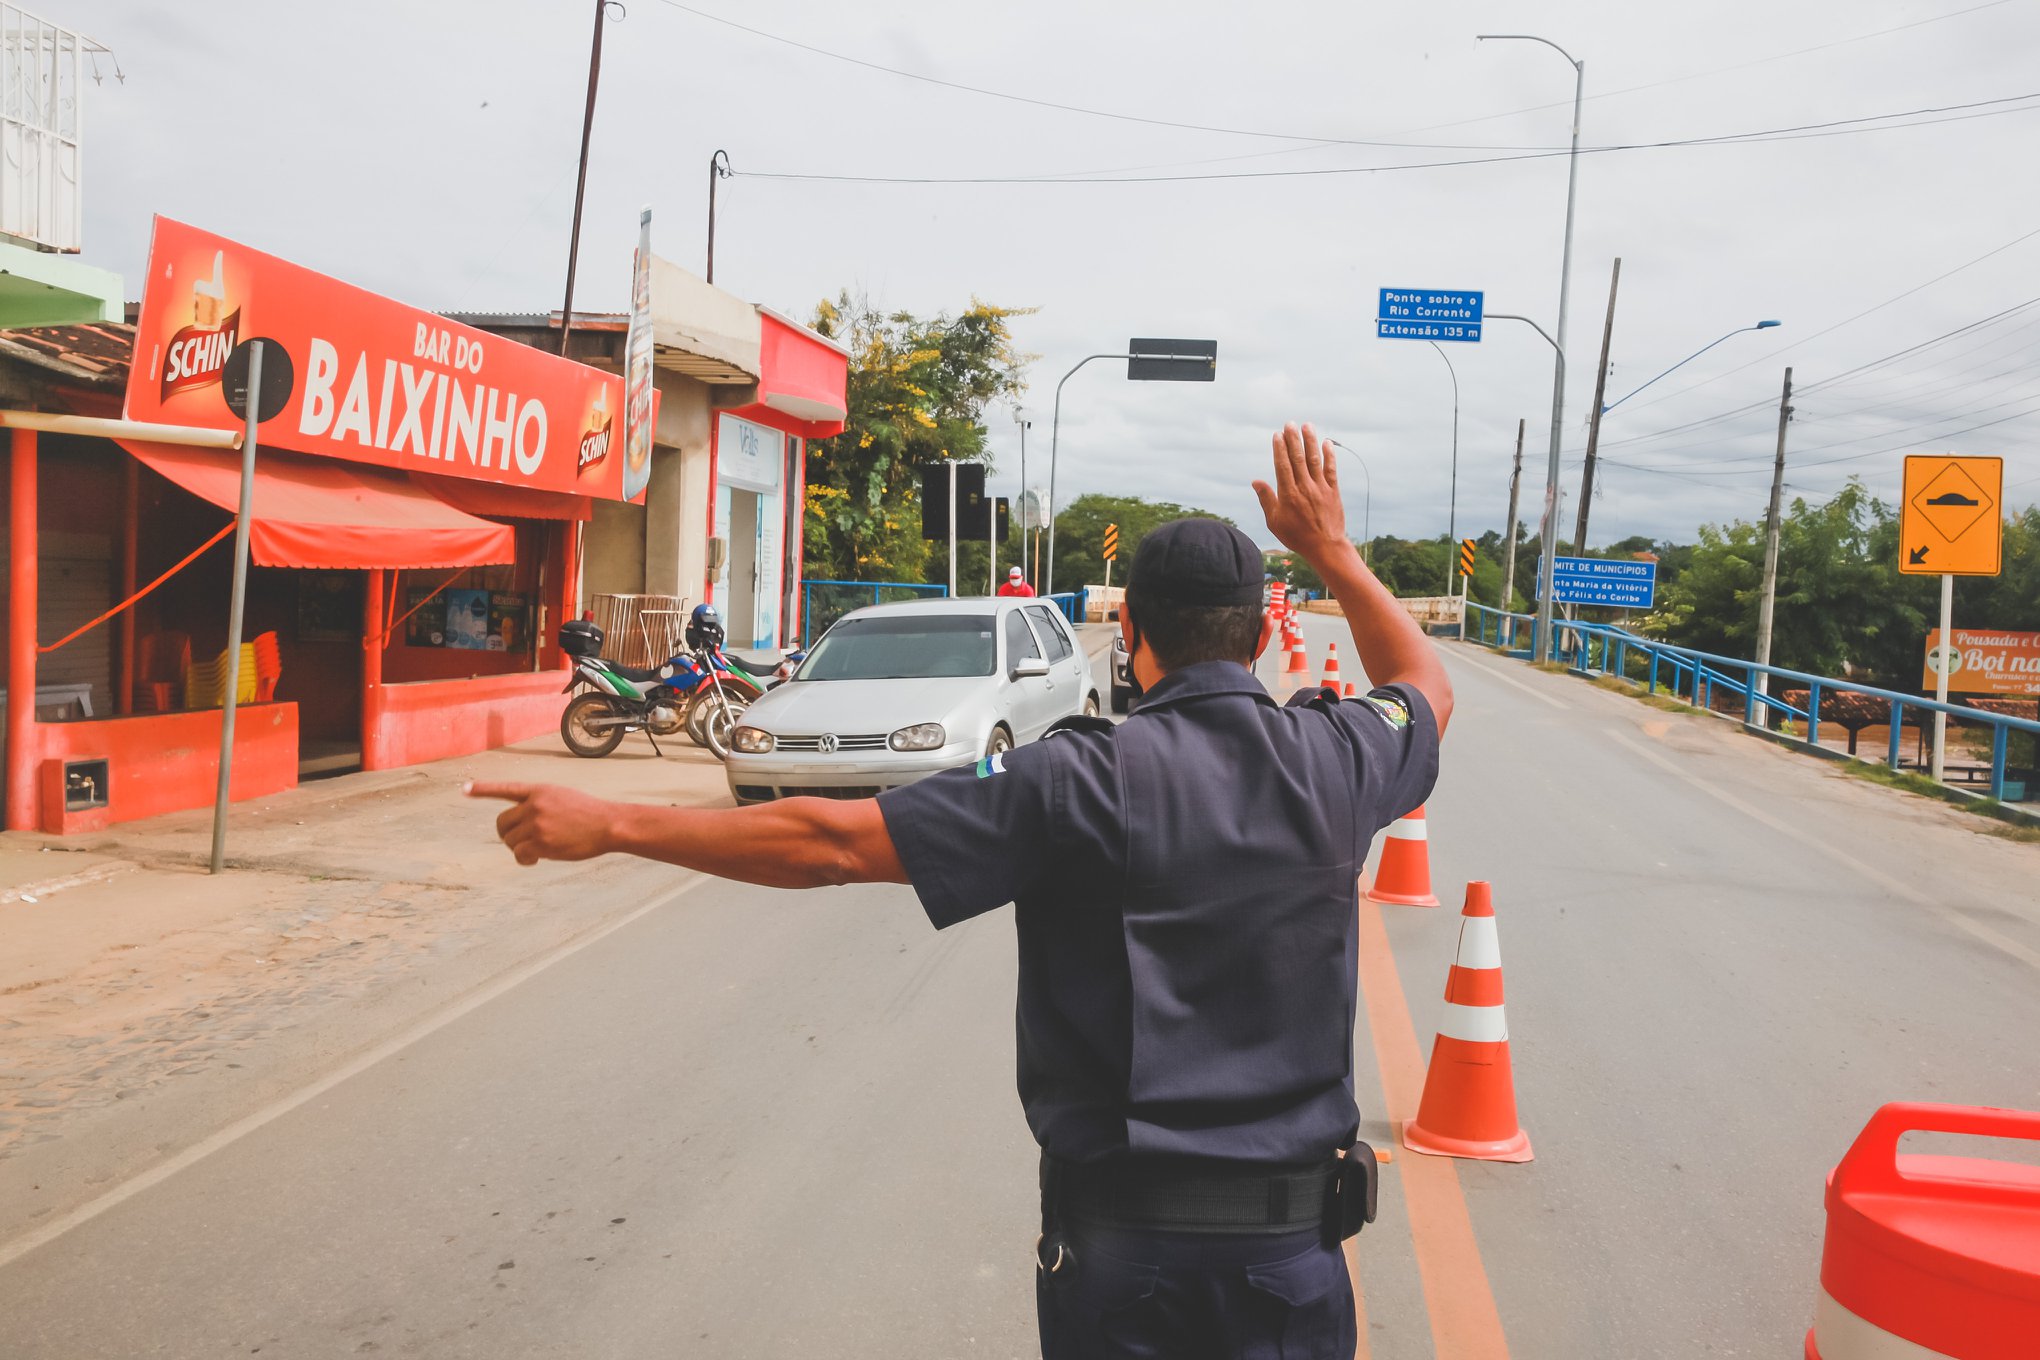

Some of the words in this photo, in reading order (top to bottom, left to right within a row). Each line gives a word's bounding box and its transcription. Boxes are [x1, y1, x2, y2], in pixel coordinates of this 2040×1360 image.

[1385, 292, 1422, 303] Ponte
[1428, 295, 1463, 305] sobre
[1469, 297, 1477, 306] o
[1389, 305, 1410, 315] Rio
[1416, 306, 1471, 318] Corrente
[1381, 324, 1439, 336] Extensão
[1444, 326, 1464, 337] 135
[1467, 329, 1478, 338] m
[166, 330, 235, 382] SCHIN
[413, 321, 451, 366] BAR
[454, 335, 484, 375] DO
[298, 337, 548, 476] BAIXINHO
[579, 429, 609, 466] SCHIN
[1554, 561, 1575, 572] MITE
[1578, 563, 1591, 572] DE
[1593, 564, 1647, 576] MUNICÍPIOS
[1554, 580, 1570, 588] nta
[1572, 580, 1599, 590] Maria
[1601, 582, 1612, 590] da
[1615, 583, 1648, 593] Vitória
[1569, 590, 1592, 599] Félix
[1596, 591, 1607, 600] do
[1610, 593, 1640, 603] Coribe
[1956, 631, 2019, 647] Pousada
[2021, 639, 2029, 648] e
[1964, 648, 2007, 672] Boi
